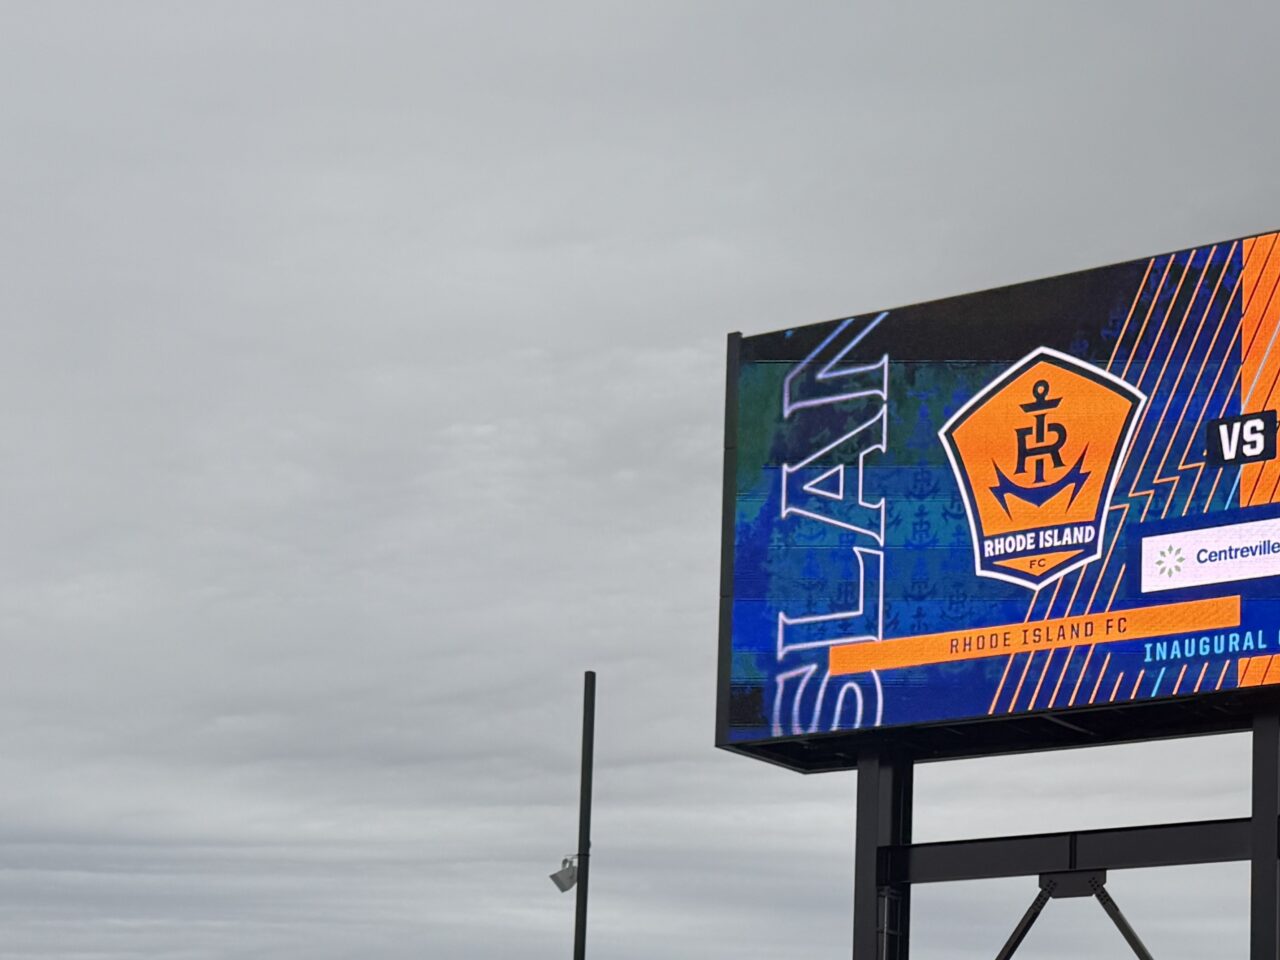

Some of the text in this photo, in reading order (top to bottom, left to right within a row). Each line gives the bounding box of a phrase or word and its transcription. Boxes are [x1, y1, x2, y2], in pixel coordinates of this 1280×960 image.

[1218, 418, 1265, 461] VS
[983, 525, 1096, 558] RHODE ISLAND
[1029, 558, 1046, 569] FC
[950, 617, 1127, 654] RHODE ISLAND FC
[1143, 629, 1267, 663] INAUGURAL
